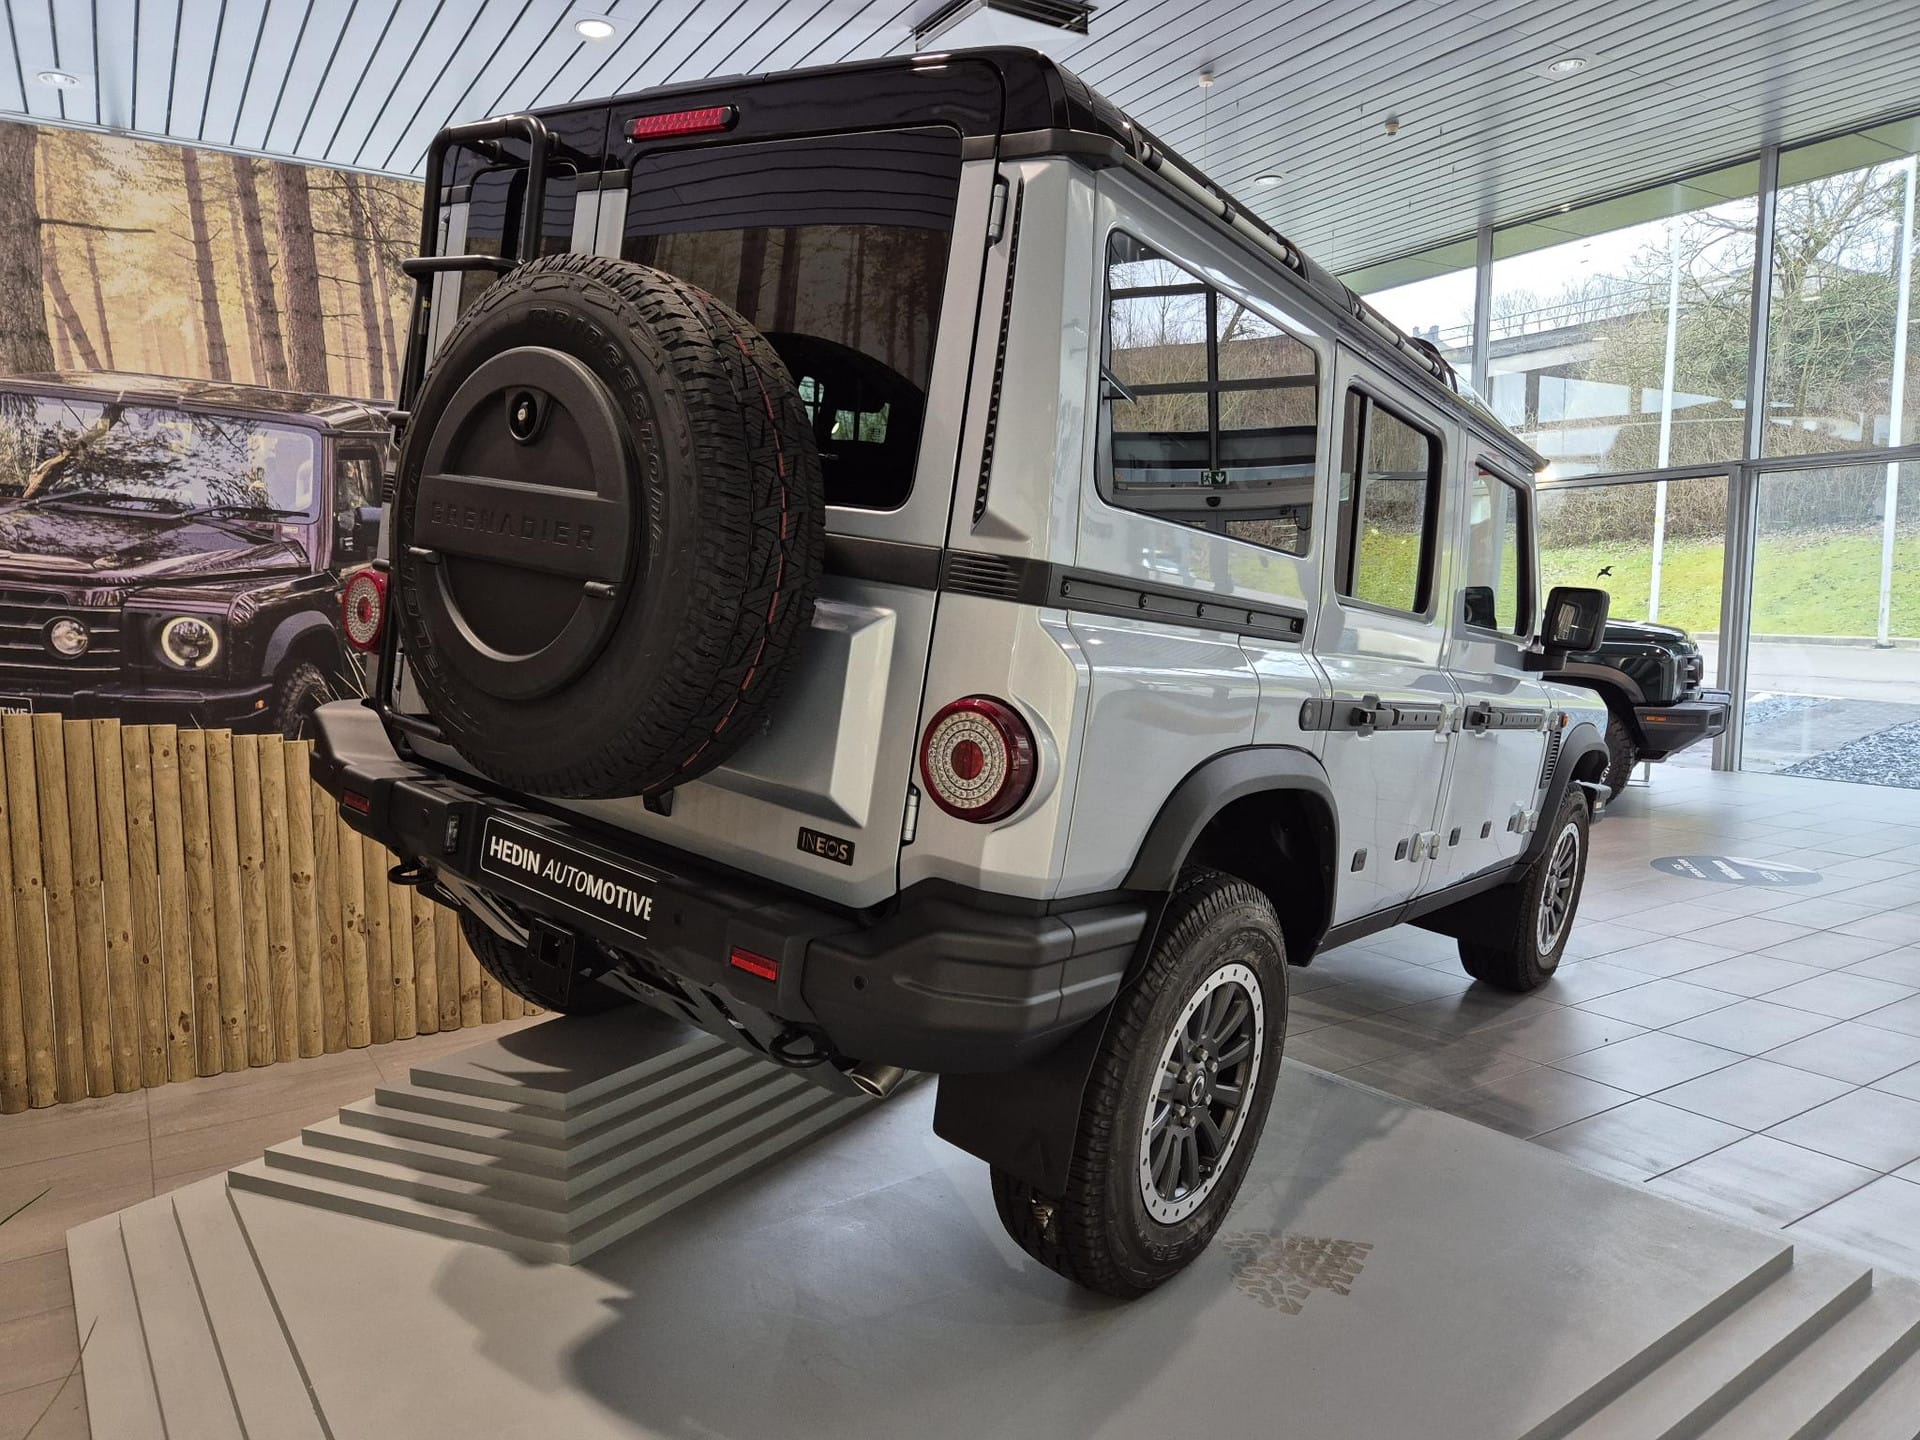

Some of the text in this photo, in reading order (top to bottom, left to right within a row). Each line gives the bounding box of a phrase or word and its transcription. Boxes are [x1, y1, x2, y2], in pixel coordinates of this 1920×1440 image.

[431, 501, 598, 552] GRENADIER
[801, 831, 849, 861] INEOS
[489, 835, 653, 921] HEDIN AUTOMOTIVE
